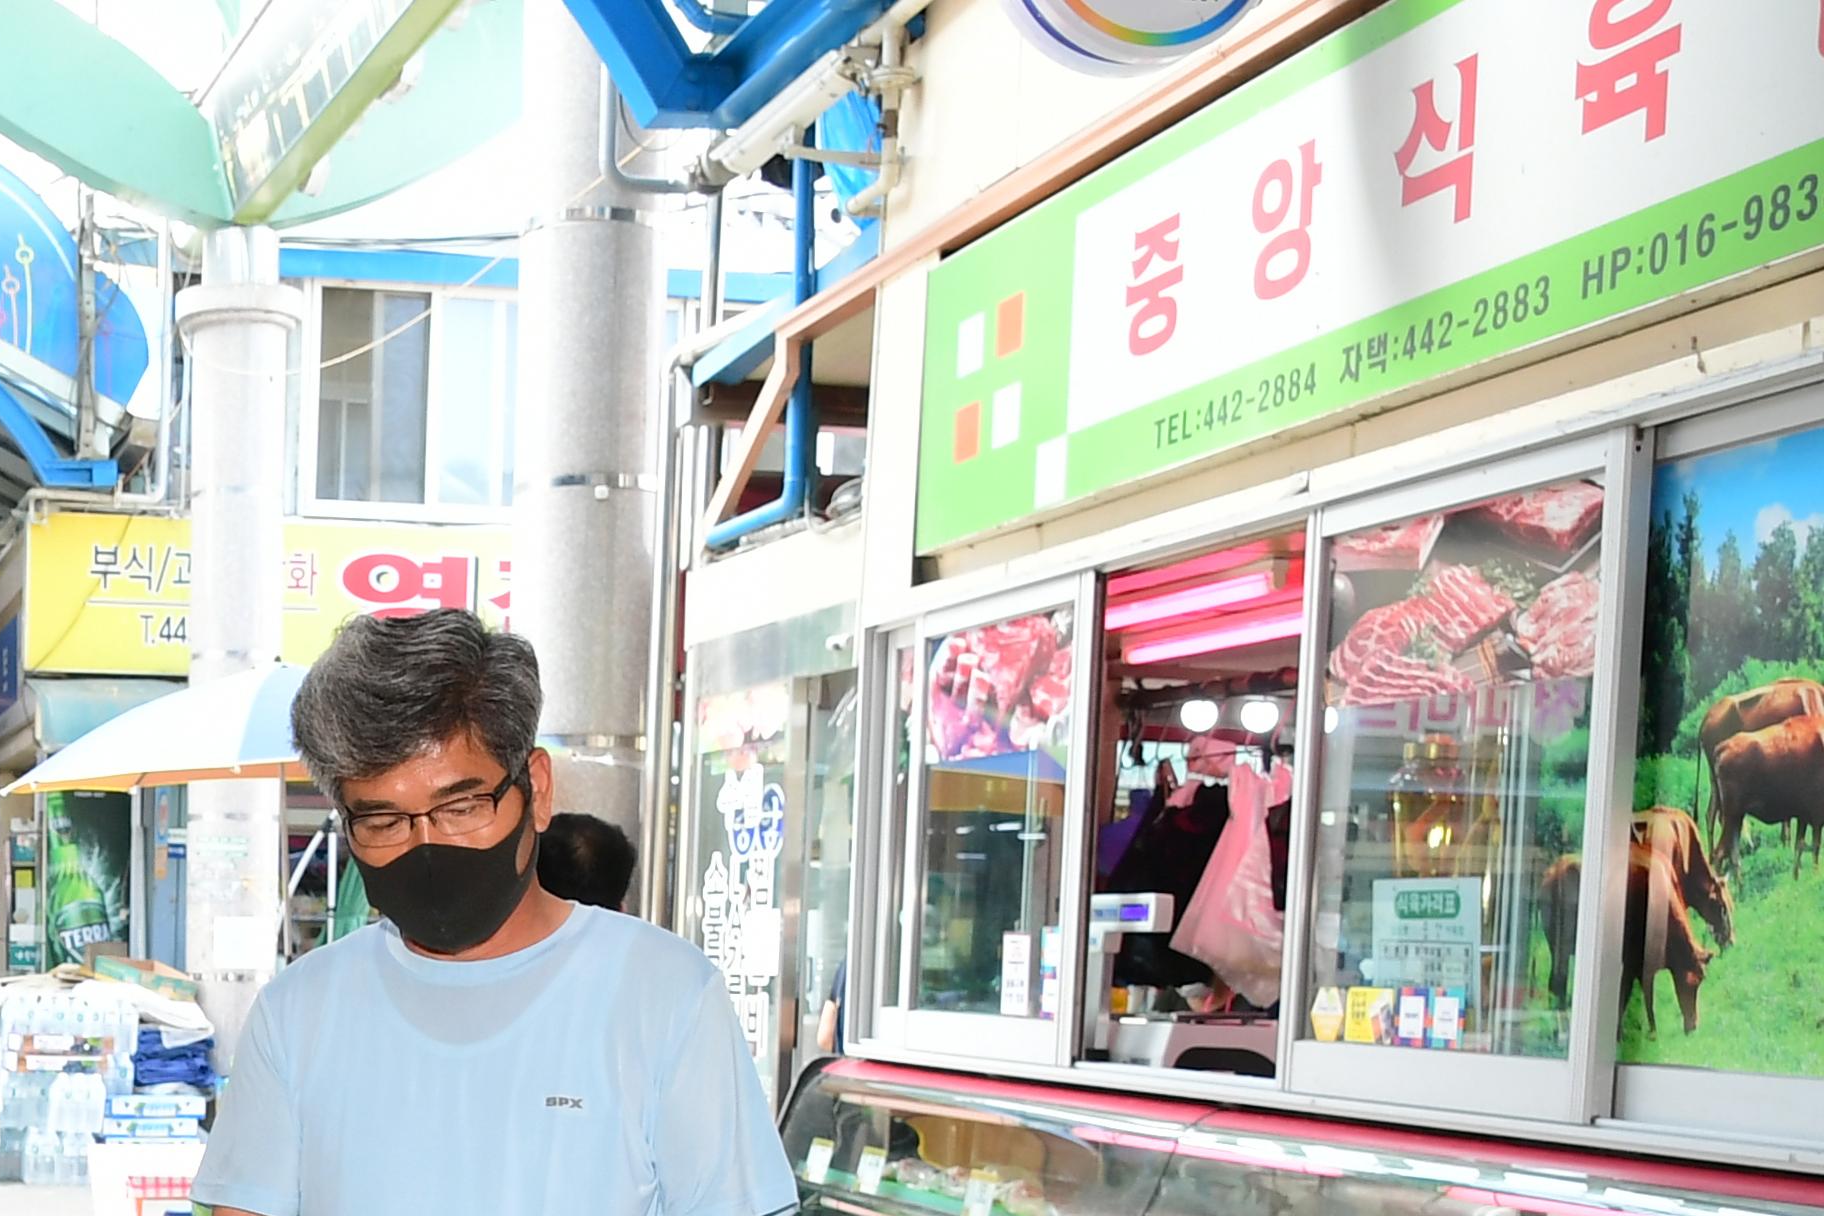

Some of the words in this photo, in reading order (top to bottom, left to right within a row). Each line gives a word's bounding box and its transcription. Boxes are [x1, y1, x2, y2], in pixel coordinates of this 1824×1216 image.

[1152, 361, 1319, 452] TEL:442-2884
[1339, 273, 1552, 387] 자택:442-2883
[282, 552, 318, 596] 화
[59, 921, 112, 951] TERRA
[544, 1095, 585, 1110] SPX
